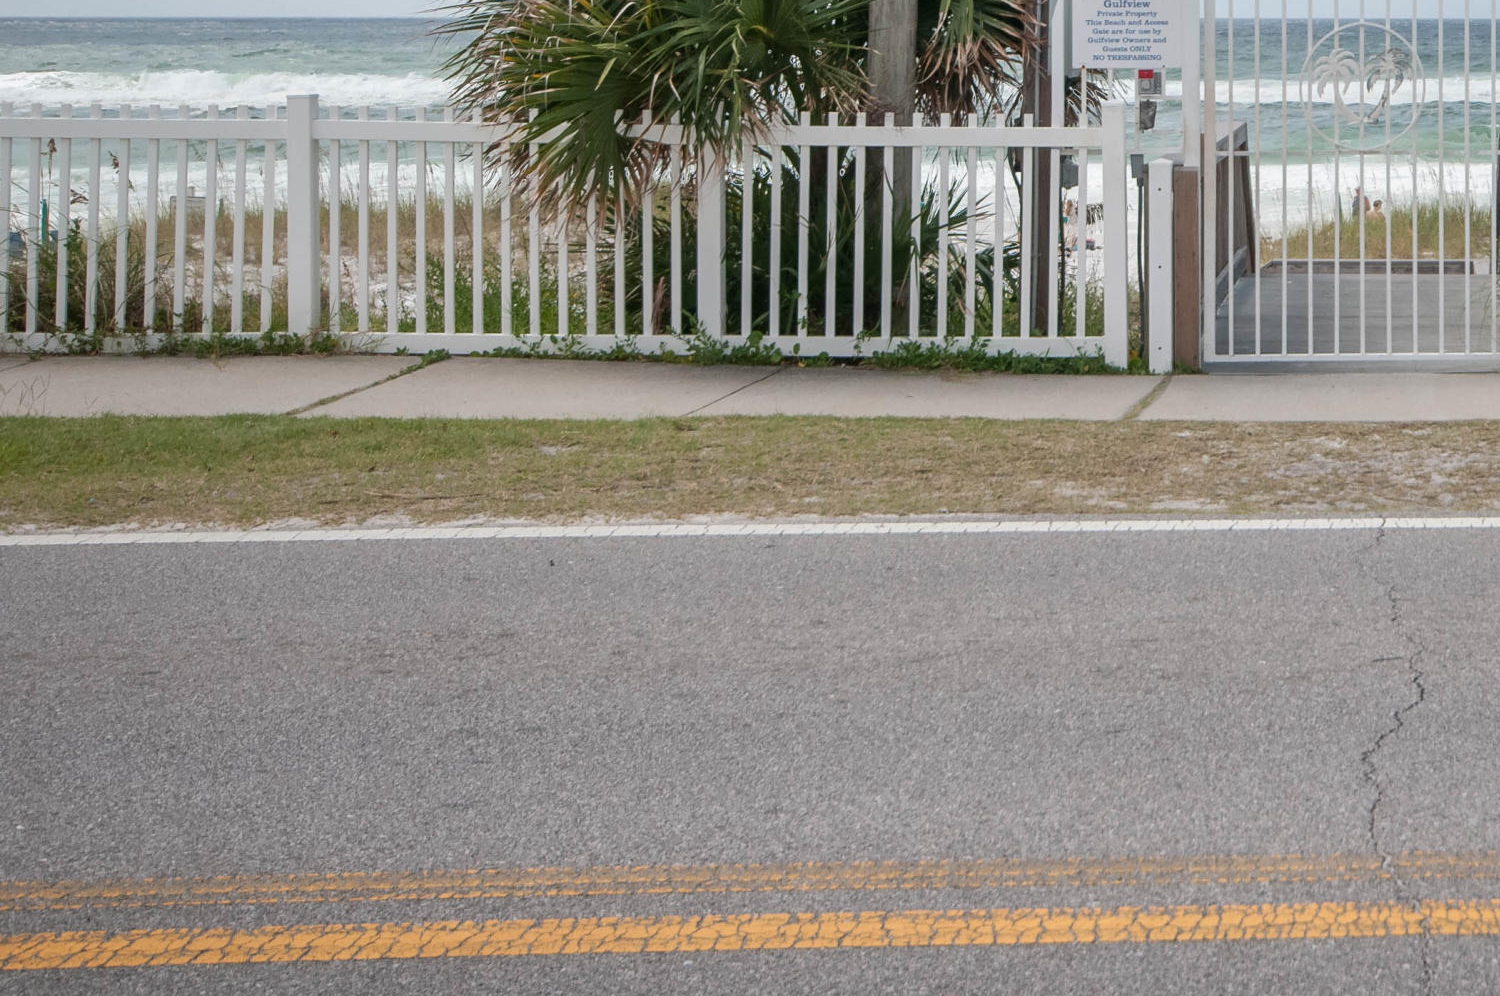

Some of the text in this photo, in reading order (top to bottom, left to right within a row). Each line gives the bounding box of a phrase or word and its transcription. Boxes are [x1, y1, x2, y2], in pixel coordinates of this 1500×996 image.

[1103, 0, 1151, 9] Gulfview
[1125, 10, 1158, 18] Property
[1152, 28, 1162, 36] by
